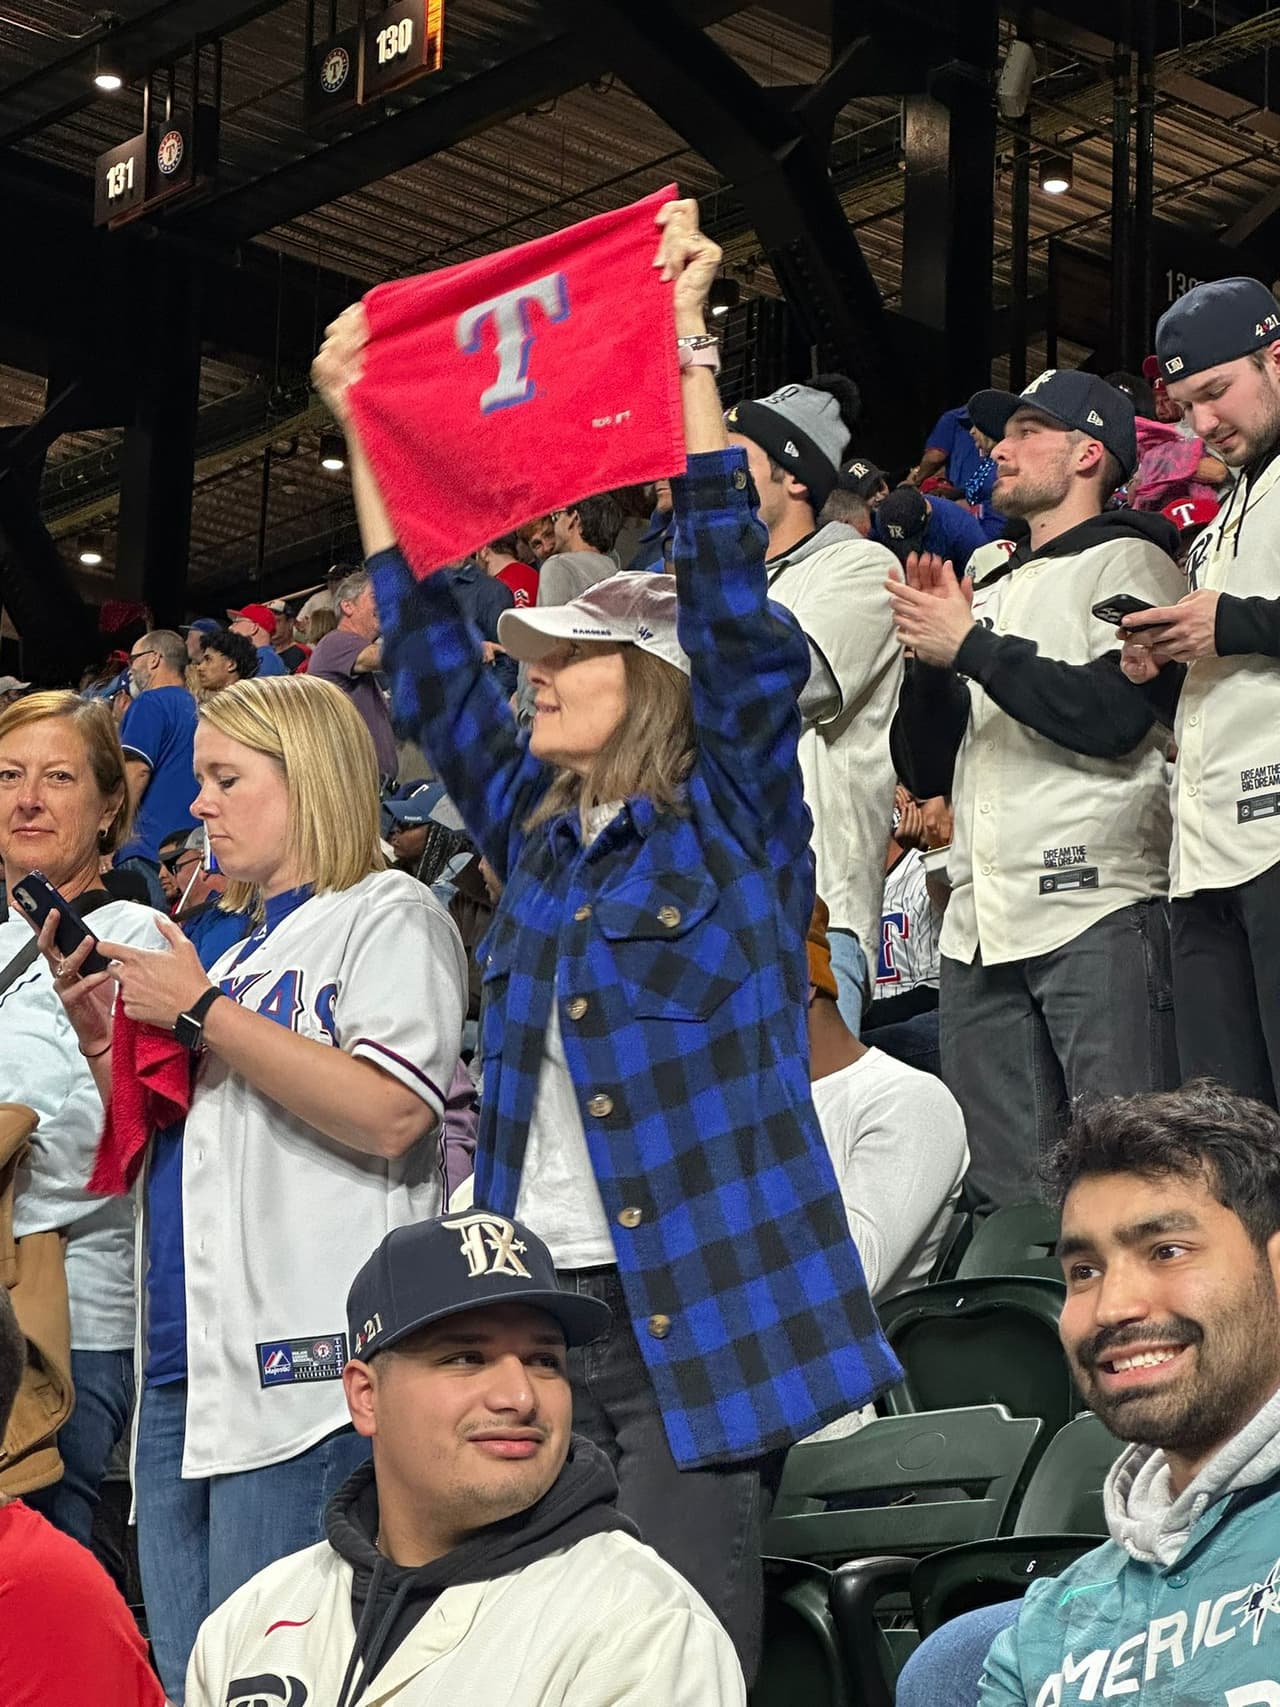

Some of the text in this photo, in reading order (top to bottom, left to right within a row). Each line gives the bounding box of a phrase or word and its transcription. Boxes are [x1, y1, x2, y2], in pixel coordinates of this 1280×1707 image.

[376, 19, 413, 64] 130
[107, 157, 134, 199] 131
[457, 271, 569, 415] T
[1171, 503, 1195, 526] T
[1241, 763, 1280, 781] DREAM THE
[1242, 778, 1255, 792] BIG
[1043, 845, 1087, 860] DREAM THE
